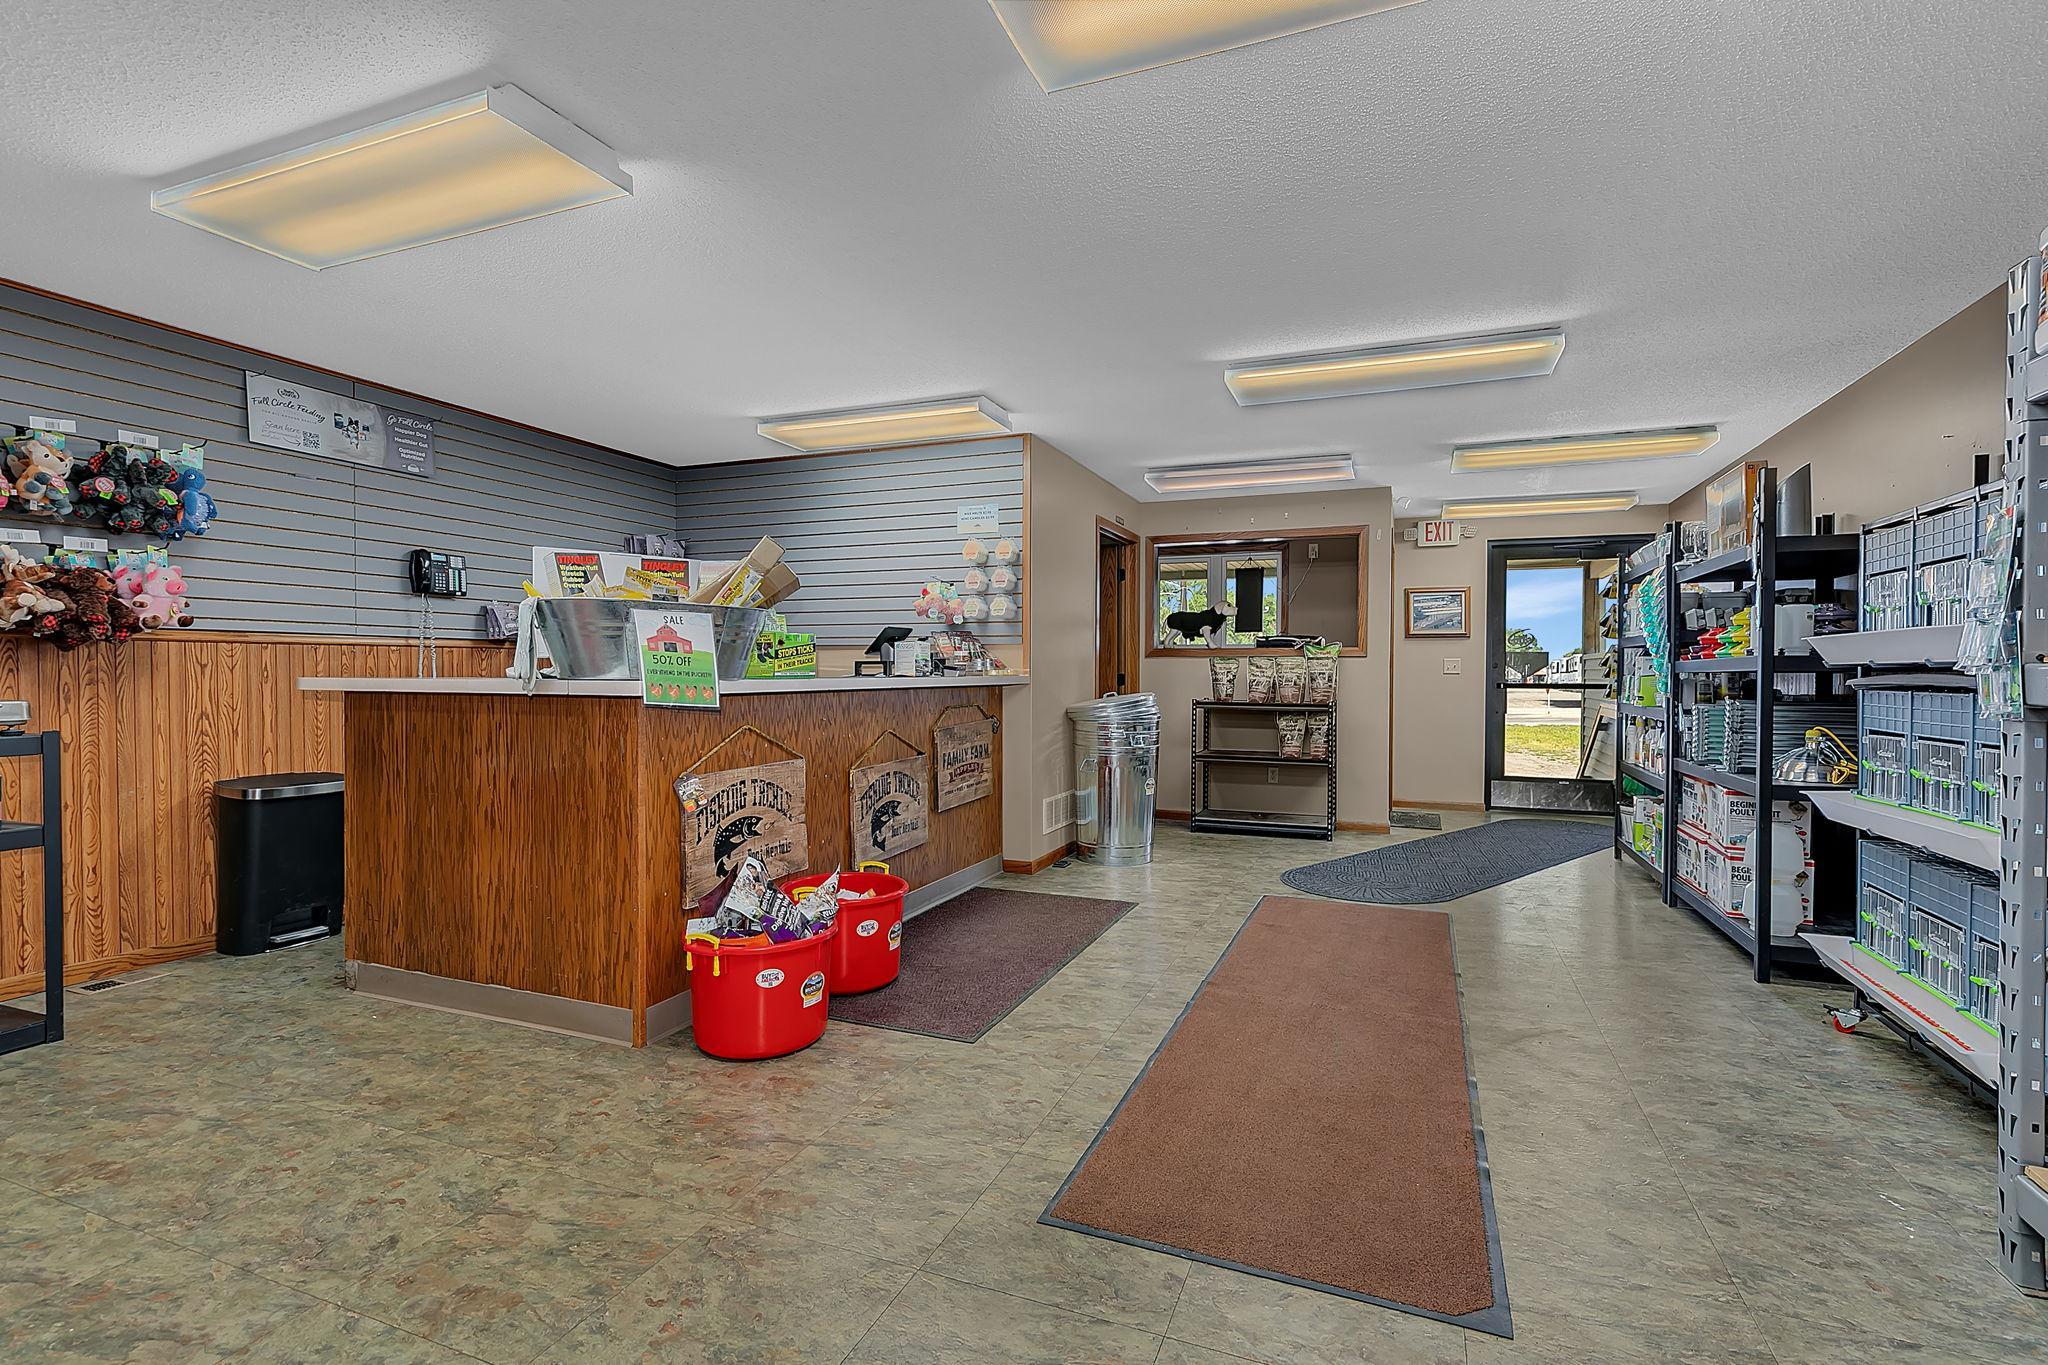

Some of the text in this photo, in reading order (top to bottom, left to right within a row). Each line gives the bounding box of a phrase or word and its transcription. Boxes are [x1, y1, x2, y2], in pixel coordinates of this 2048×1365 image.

[251, 396, 326, 424] Full Circle Feeding
[398, 417, 413, 428] Full
[412, 420, 433, 431] Circle
[1425, 521, 1454, 542] EXIT
[557, 554, 598, 565] TINGLEY
[643, 561, 687, 571] TINGLEY
[663, 615, 684, 625] SALE
[777, 647, 797, 659] STOPS
[797, 644, 814, 655] TICKS
[652, 654, 692, 666] 50% OFF
[783, 659, 796, 669] THEIR
[942, 743, 991, 770] FAMILY FARM
[859, 770, 921, 823] FISHING TACKLE
[696, 778, 793, 846] FISHING TACKLE
[1730, 808, 1756, 817] POULT
[1731, 874, 1752, 882] POUL
